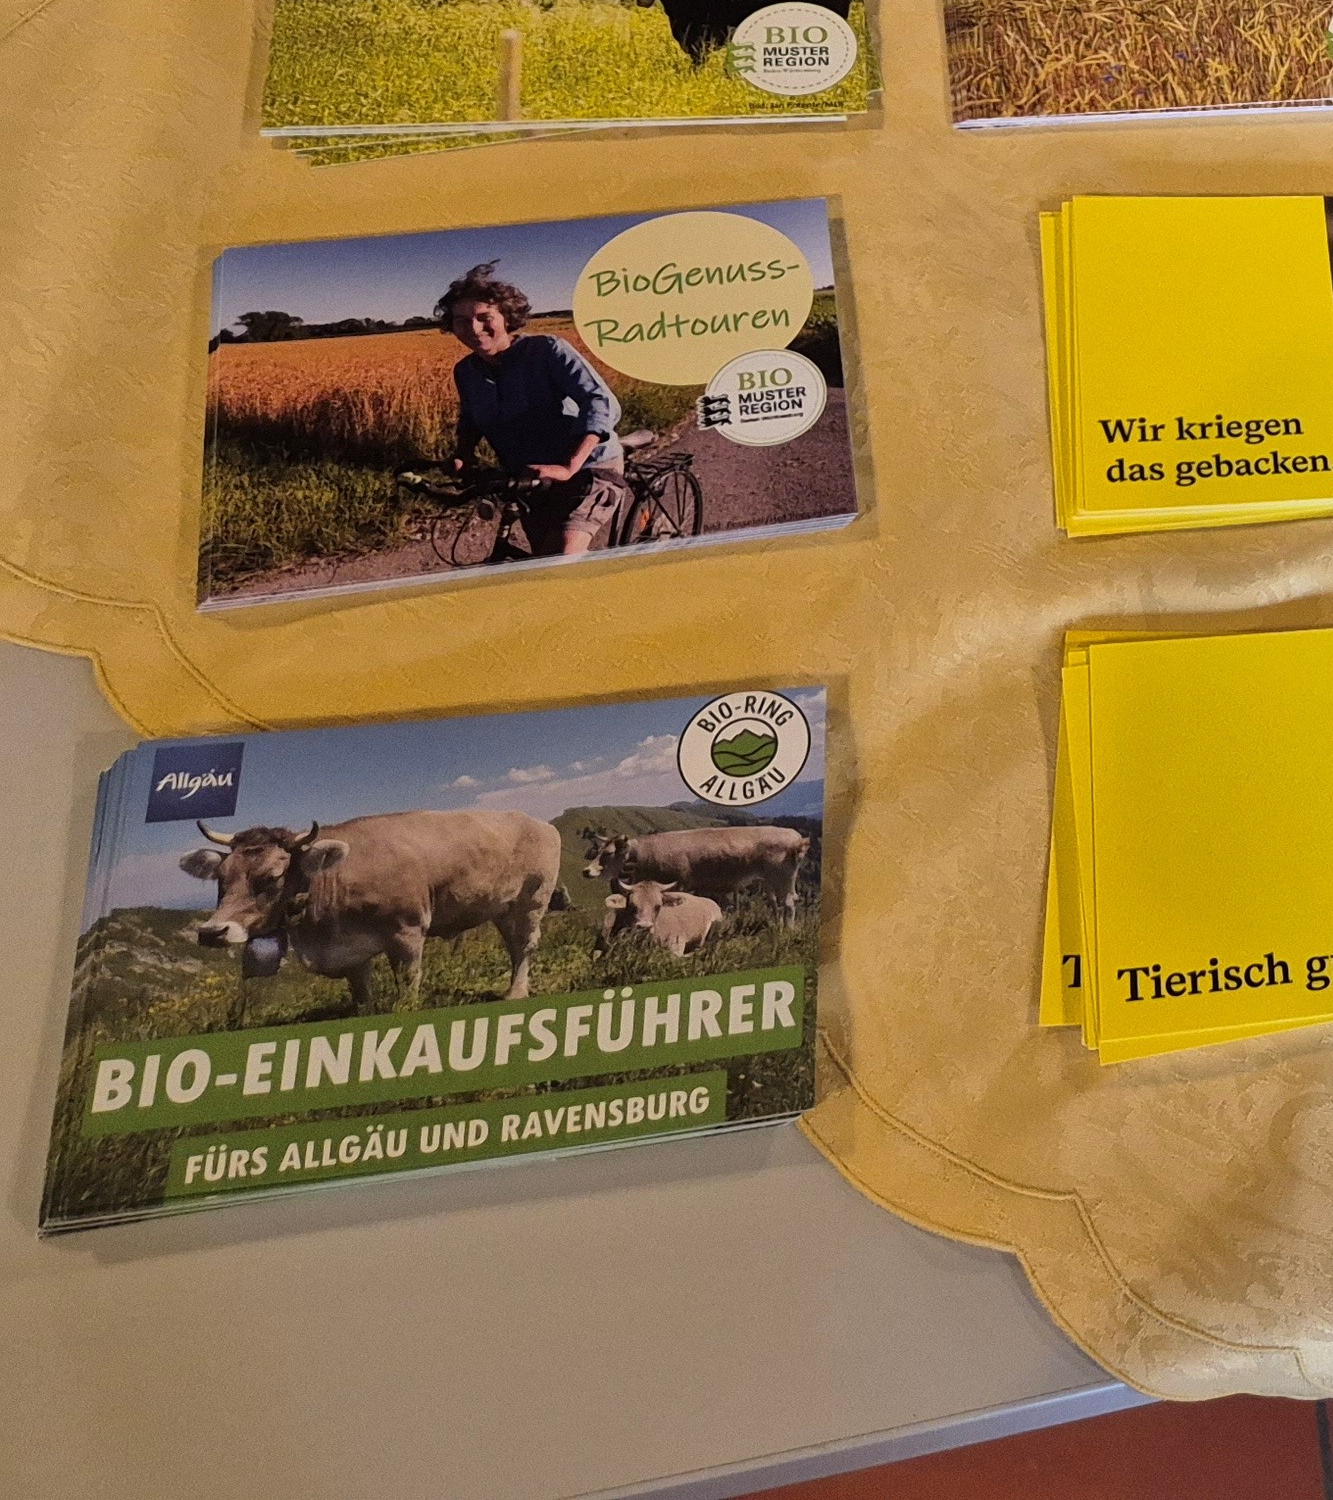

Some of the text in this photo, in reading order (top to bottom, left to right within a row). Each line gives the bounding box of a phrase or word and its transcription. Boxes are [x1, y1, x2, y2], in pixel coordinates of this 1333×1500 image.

[763, 46, 830, 56] MUSTER
[764, 25, 828, 45] BIO
[763, 56, 830, 67] REGION
[588, 257, 800, 298] BioGenuss-
[583, 307, 791, 348] Radtouren
[737, 367, 793, 391] BIO
[738, 386, 807, 404] MUSTER
[739, 398, 803, 416] REGION
[1099, 412, 1305, 445] Wir kriegen
[1106, 457, 1165, 483] das
[696, 695, 794, 733] BIO-RING
[156, 767, 235, 800] Allgäu
[699, 766, 786, 801] ALLGÄU
[1117, 951, 1294, 1004] Tierisch
[90, 978, 796, 1114] BIO-EINKAUFSFÜHRER
[184, 1084, 711, 1184] FÜRS ALLGÄU UND RAVENSBURG
